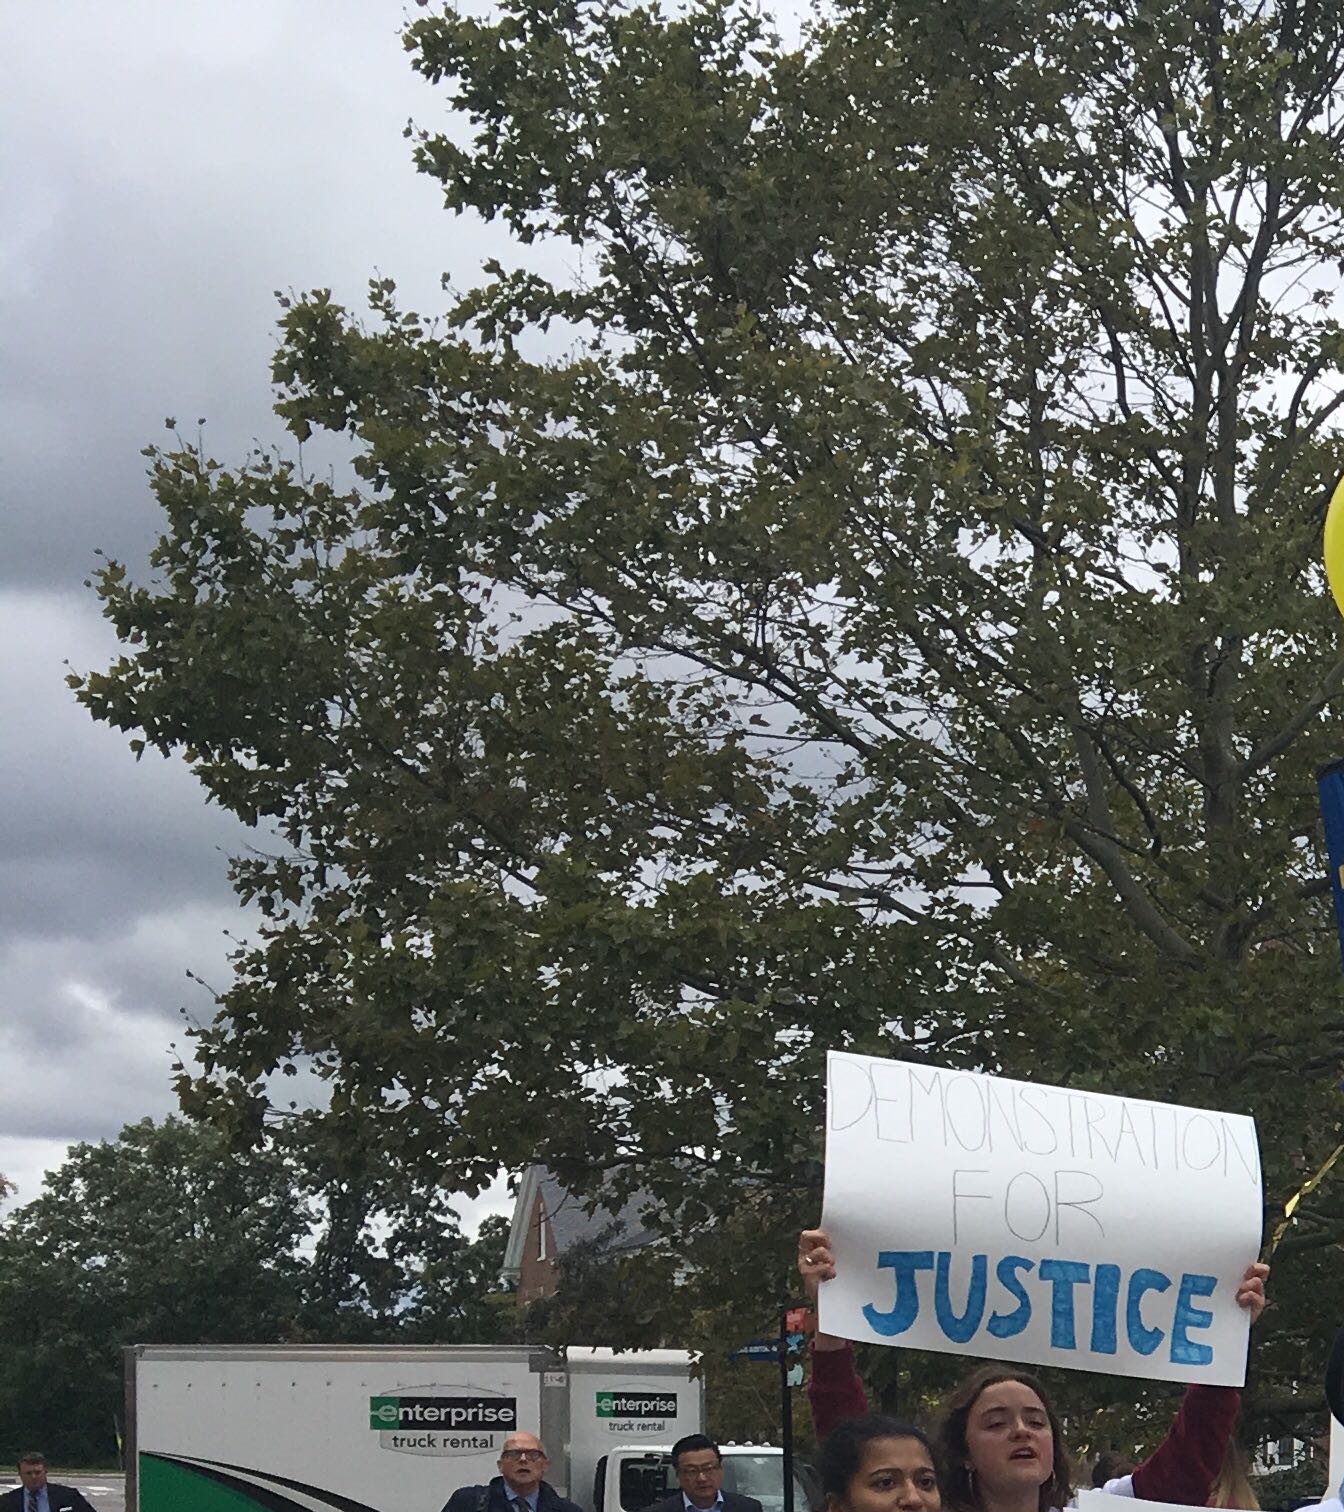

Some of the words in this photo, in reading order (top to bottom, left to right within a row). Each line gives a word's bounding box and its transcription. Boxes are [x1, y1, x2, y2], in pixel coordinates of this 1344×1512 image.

[828, 1057, 1259, 1186] DEMONSTRATION
[953, 1169, 1106, 1246] FOR
[861, 1249, 1219, 1367] JUSTICE
[371, 1402, 515, 1427] enterprise
[597, 1396, 677, 1414] enterprise
[608, 1420, 639, 1432] truck
[641, 1420, 666, 1432] rental
[391, 1434, 436, 1449] truck
[443, 1434, 494, 1449] rental
